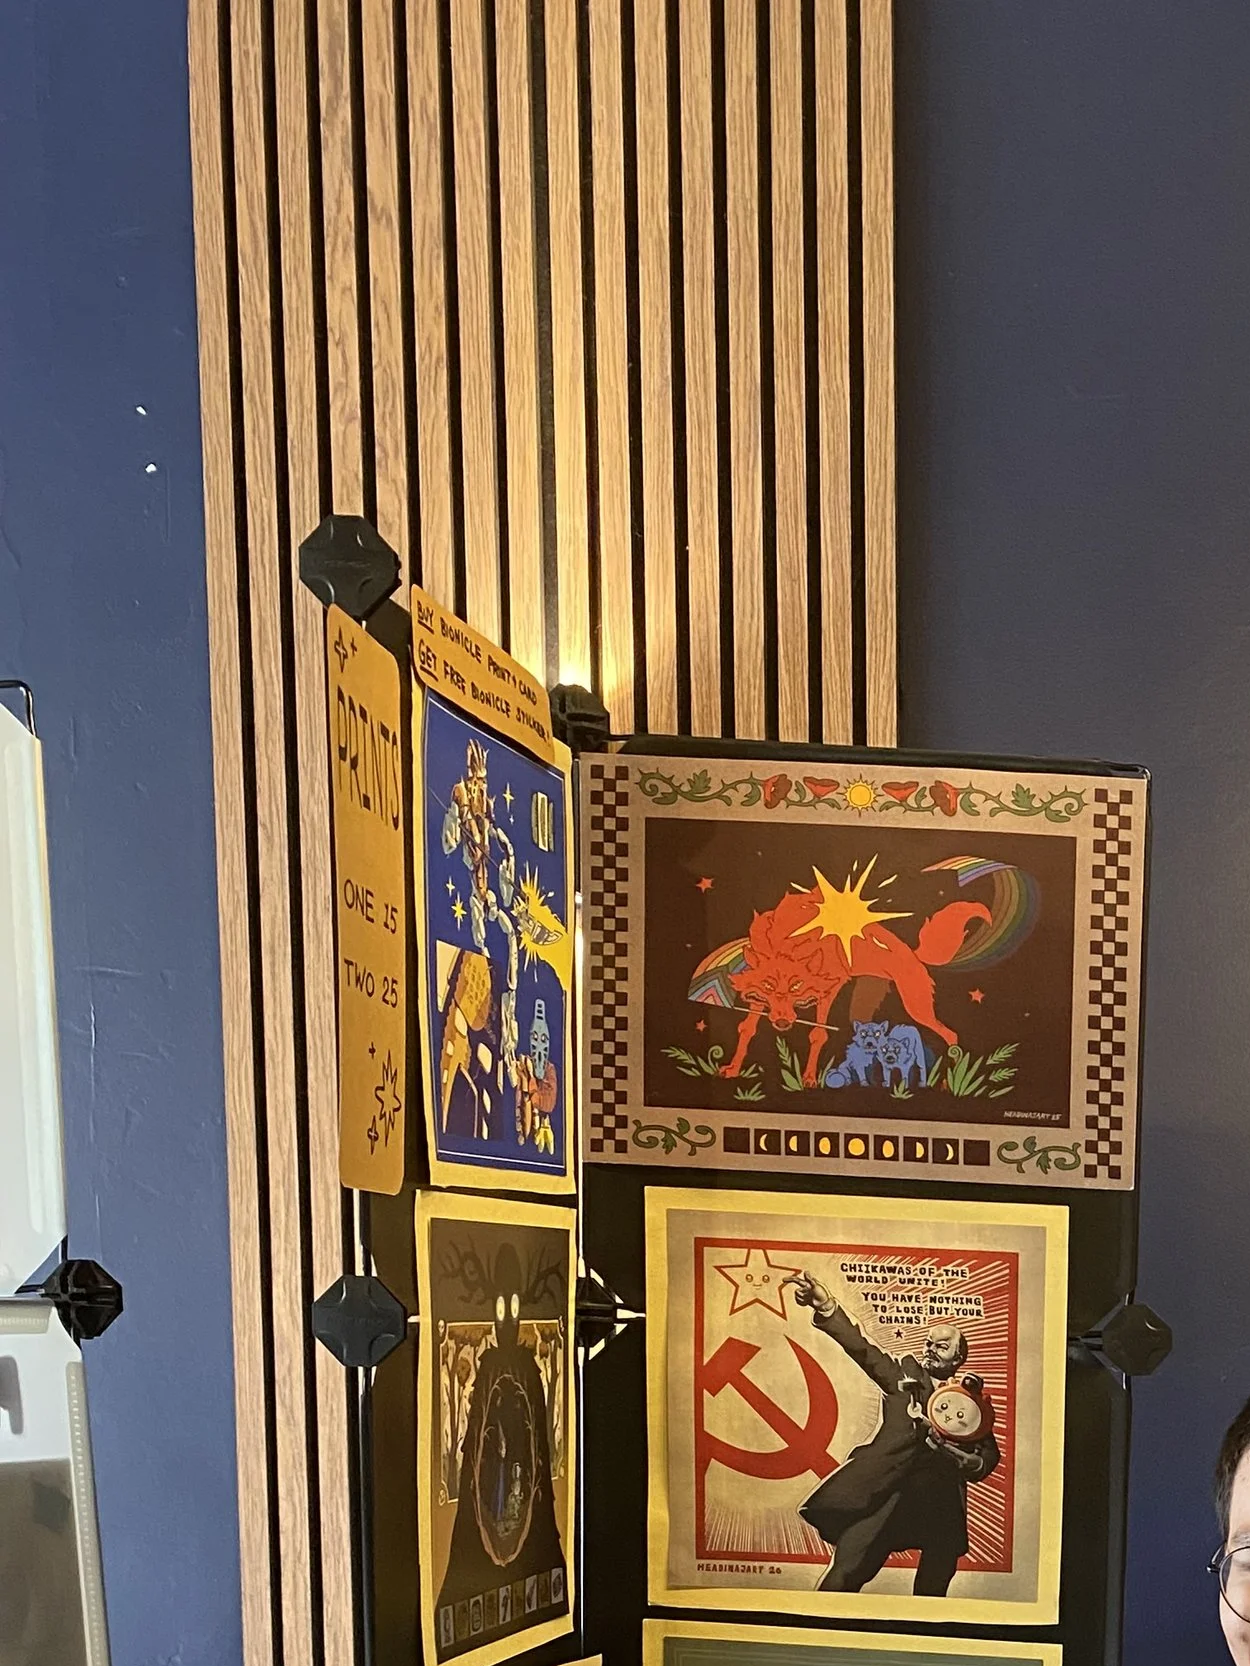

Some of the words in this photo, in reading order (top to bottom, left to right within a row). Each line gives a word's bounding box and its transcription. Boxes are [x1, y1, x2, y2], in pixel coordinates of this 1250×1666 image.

[440, 617, 482, 664] BIONICLE
[418, 639, 437, 671] GET
[443, 659, 466, 696] FREE
[470, 681, 510, 718] BIONICLE
[336, 686, 400, 833] PRINTS
[343, 879, 376, 926] ONE
[383, 900, 398, 935] 15
[343, 957, 376, 998] TWO
[381, 975, 399, 1009] 25
[840, 1262, 912, 1275] CHIIKAWAS
[918, 1267, 935, 1276] OF
[943, 1268, 968, 1278] THE
[846, 1275, 888, 1285] WORLD
[898, 1277, 945, 1287] UNITE!
[861, 1291, 886, 1301] YOU
[892, 1293, 921, 1303] HAVE
[929, 1295, 982, 1306] NOTHING
[872, 1304, 887, 1313] TO
[895, 1305, 924, 1314] LOSE
[929, 1306, 950, 1315] BUT
[954, 1307, 983, 1317] YOUR
[879, 1315, 927, 1325] CHAINS!
